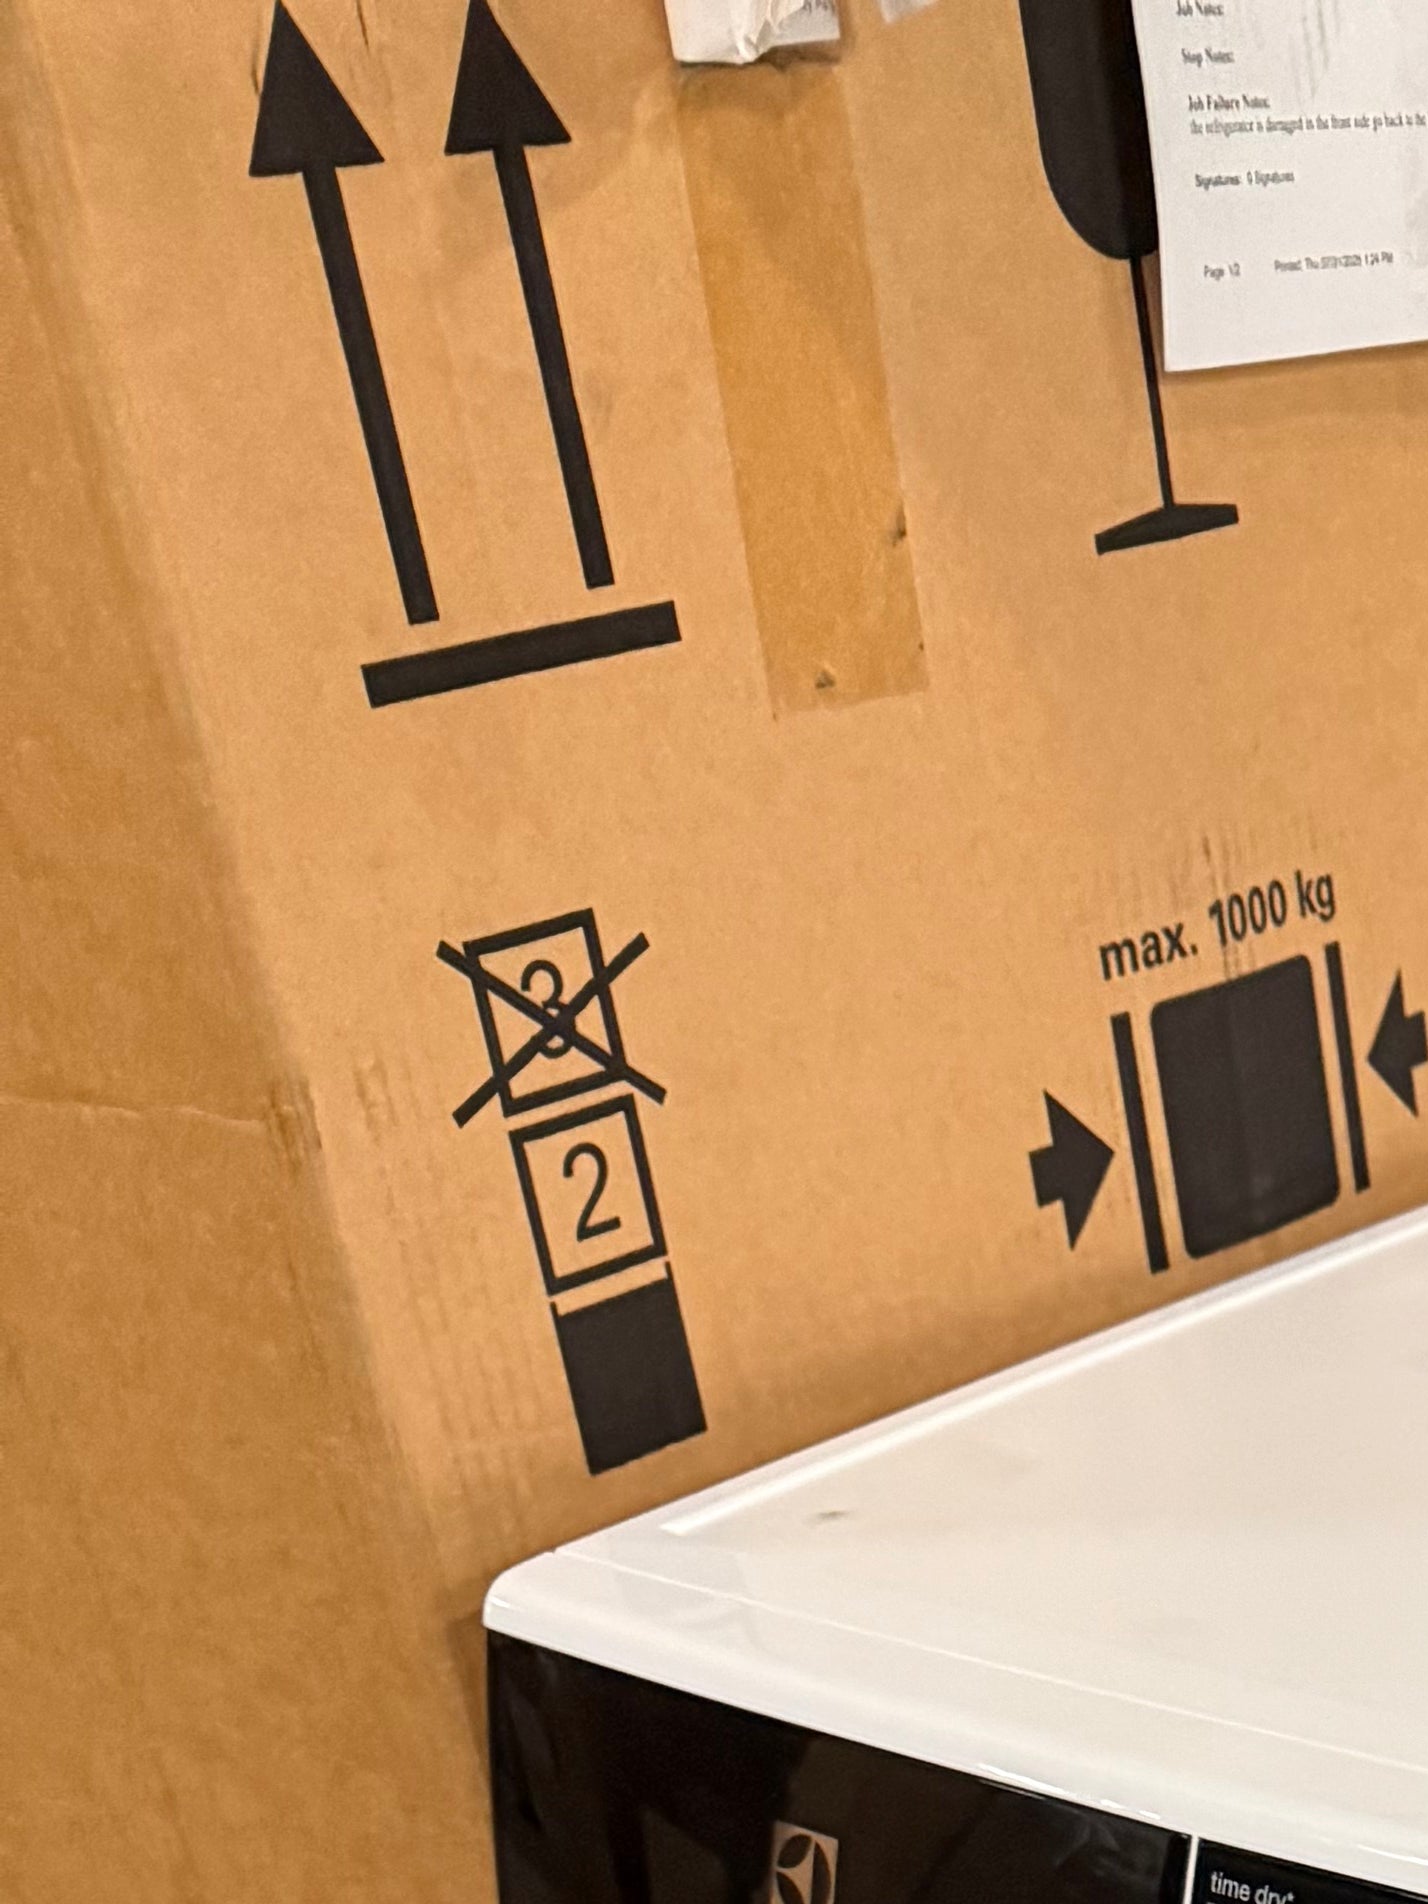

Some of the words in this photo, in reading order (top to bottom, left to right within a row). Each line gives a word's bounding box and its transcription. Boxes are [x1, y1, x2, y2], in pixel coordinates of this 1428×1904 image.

[1099, 922, 1198, 981] max.
[1208, 879, 1287, 947] 1000
[1294, 869, 1336, 922] kg
[560, 1142, 623, 1241] 2
[1210, 1871, 1250, 1902] time
